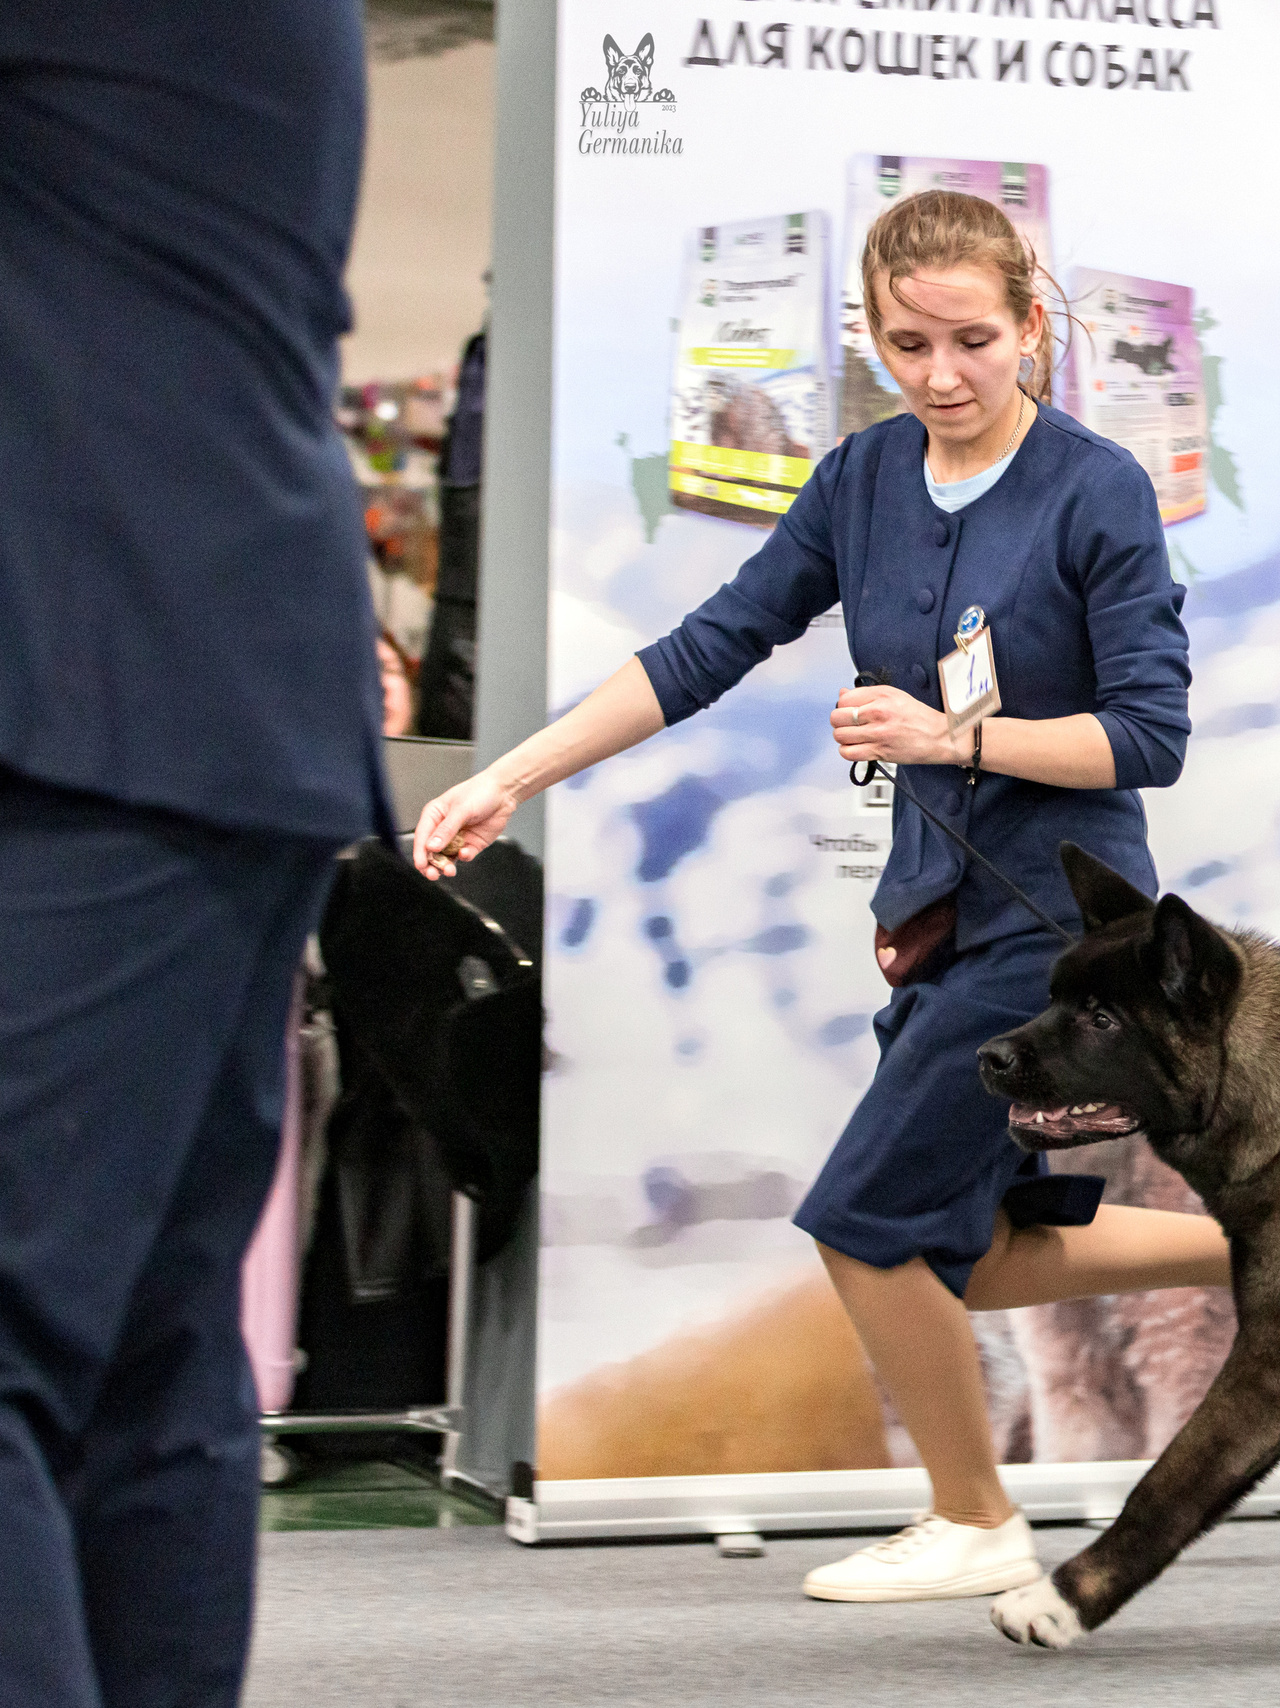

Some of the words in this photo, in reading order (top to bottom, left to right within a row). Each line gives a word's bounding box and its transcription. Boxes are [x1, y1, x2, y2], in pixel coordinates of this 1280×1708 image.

[683, 18, 793, 69] ДЛЯ
[804, 26, 980, 82] КОШЕК
[993, 39, 1029, 84] И
[1043, 40, 1194, 91] СОБАК
